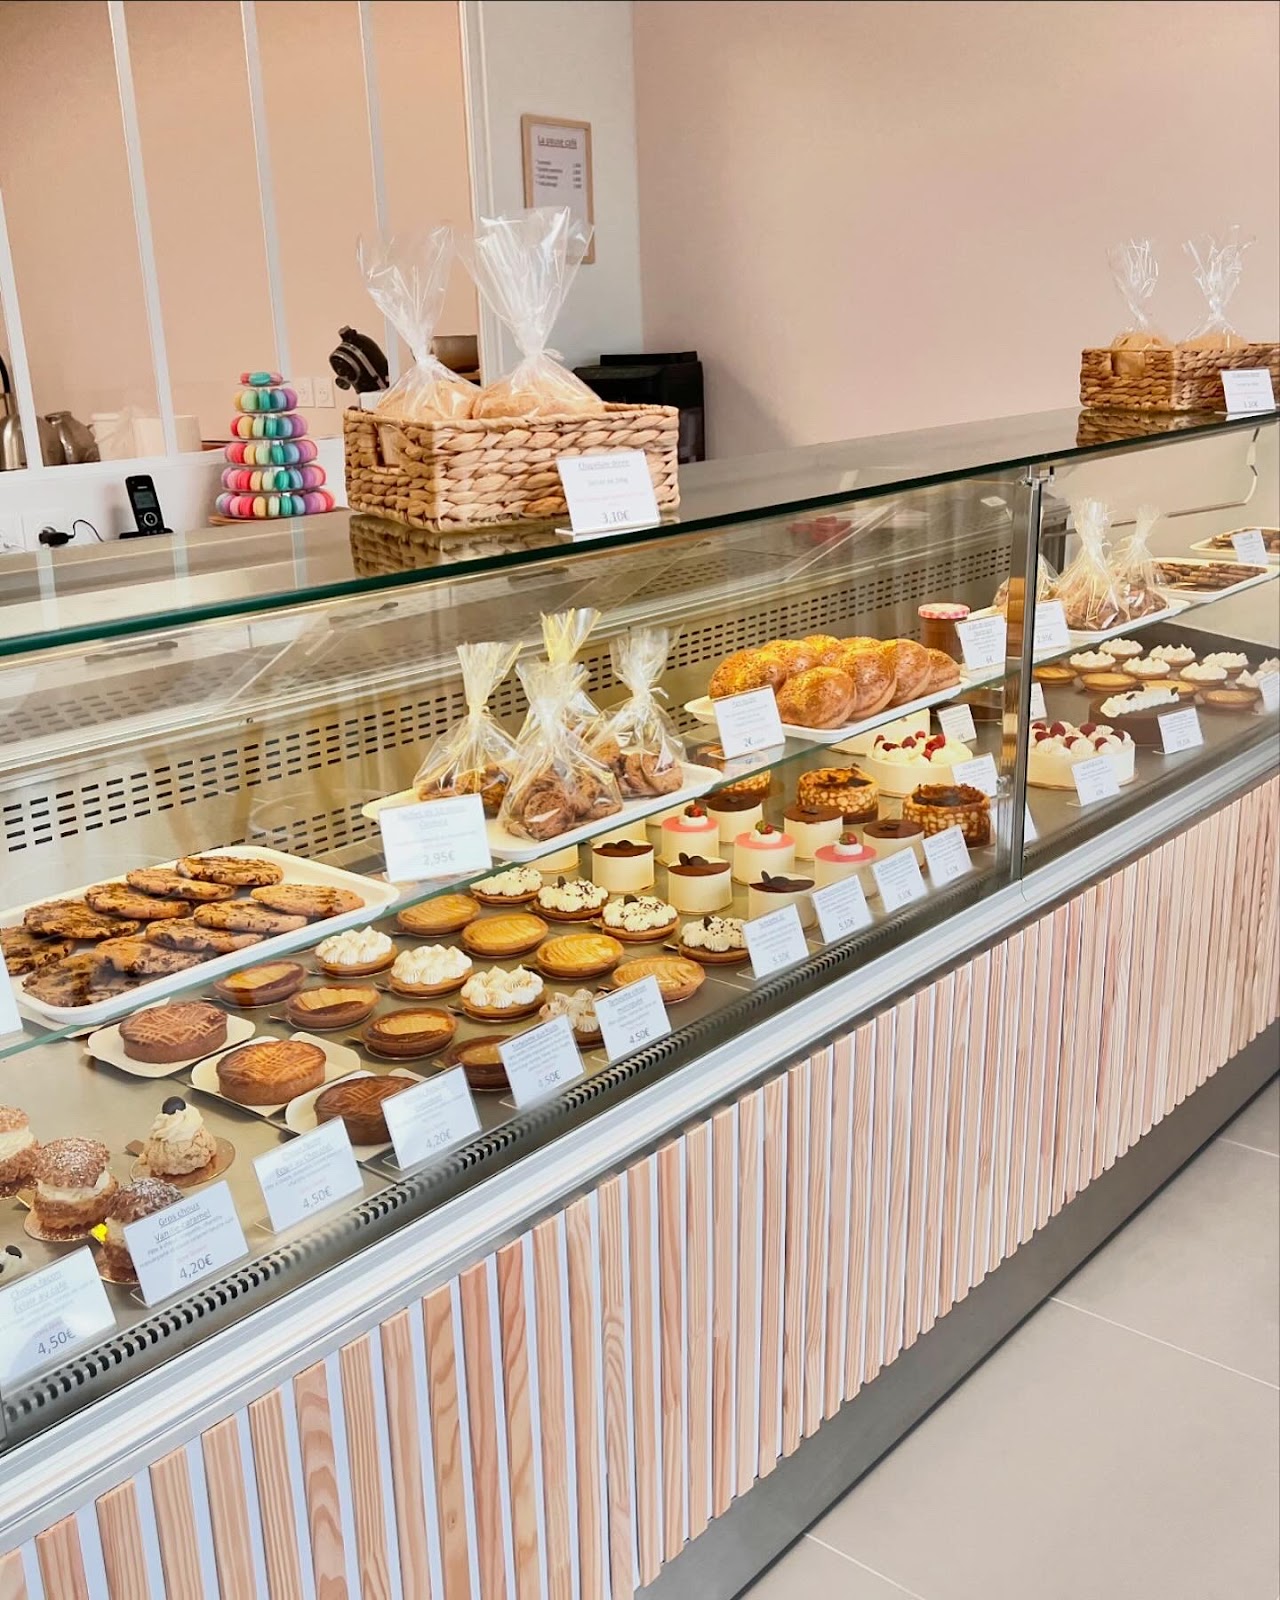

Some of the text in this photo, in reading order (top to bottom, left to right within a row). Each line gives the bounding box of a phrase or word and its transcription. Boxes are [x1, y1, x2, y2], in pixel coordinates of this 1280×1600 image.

[426, 1128, 453, 1149] 4,20€
[303, 1185, 333, 1209] 4,50€
[159, 1203, 200, 1227] Gros choux
[181, 1208, 211, 1227] caramel
[180, 1253, 213, 1279] 4,20€
[38, 1328, 76, 1354] 4,50€
